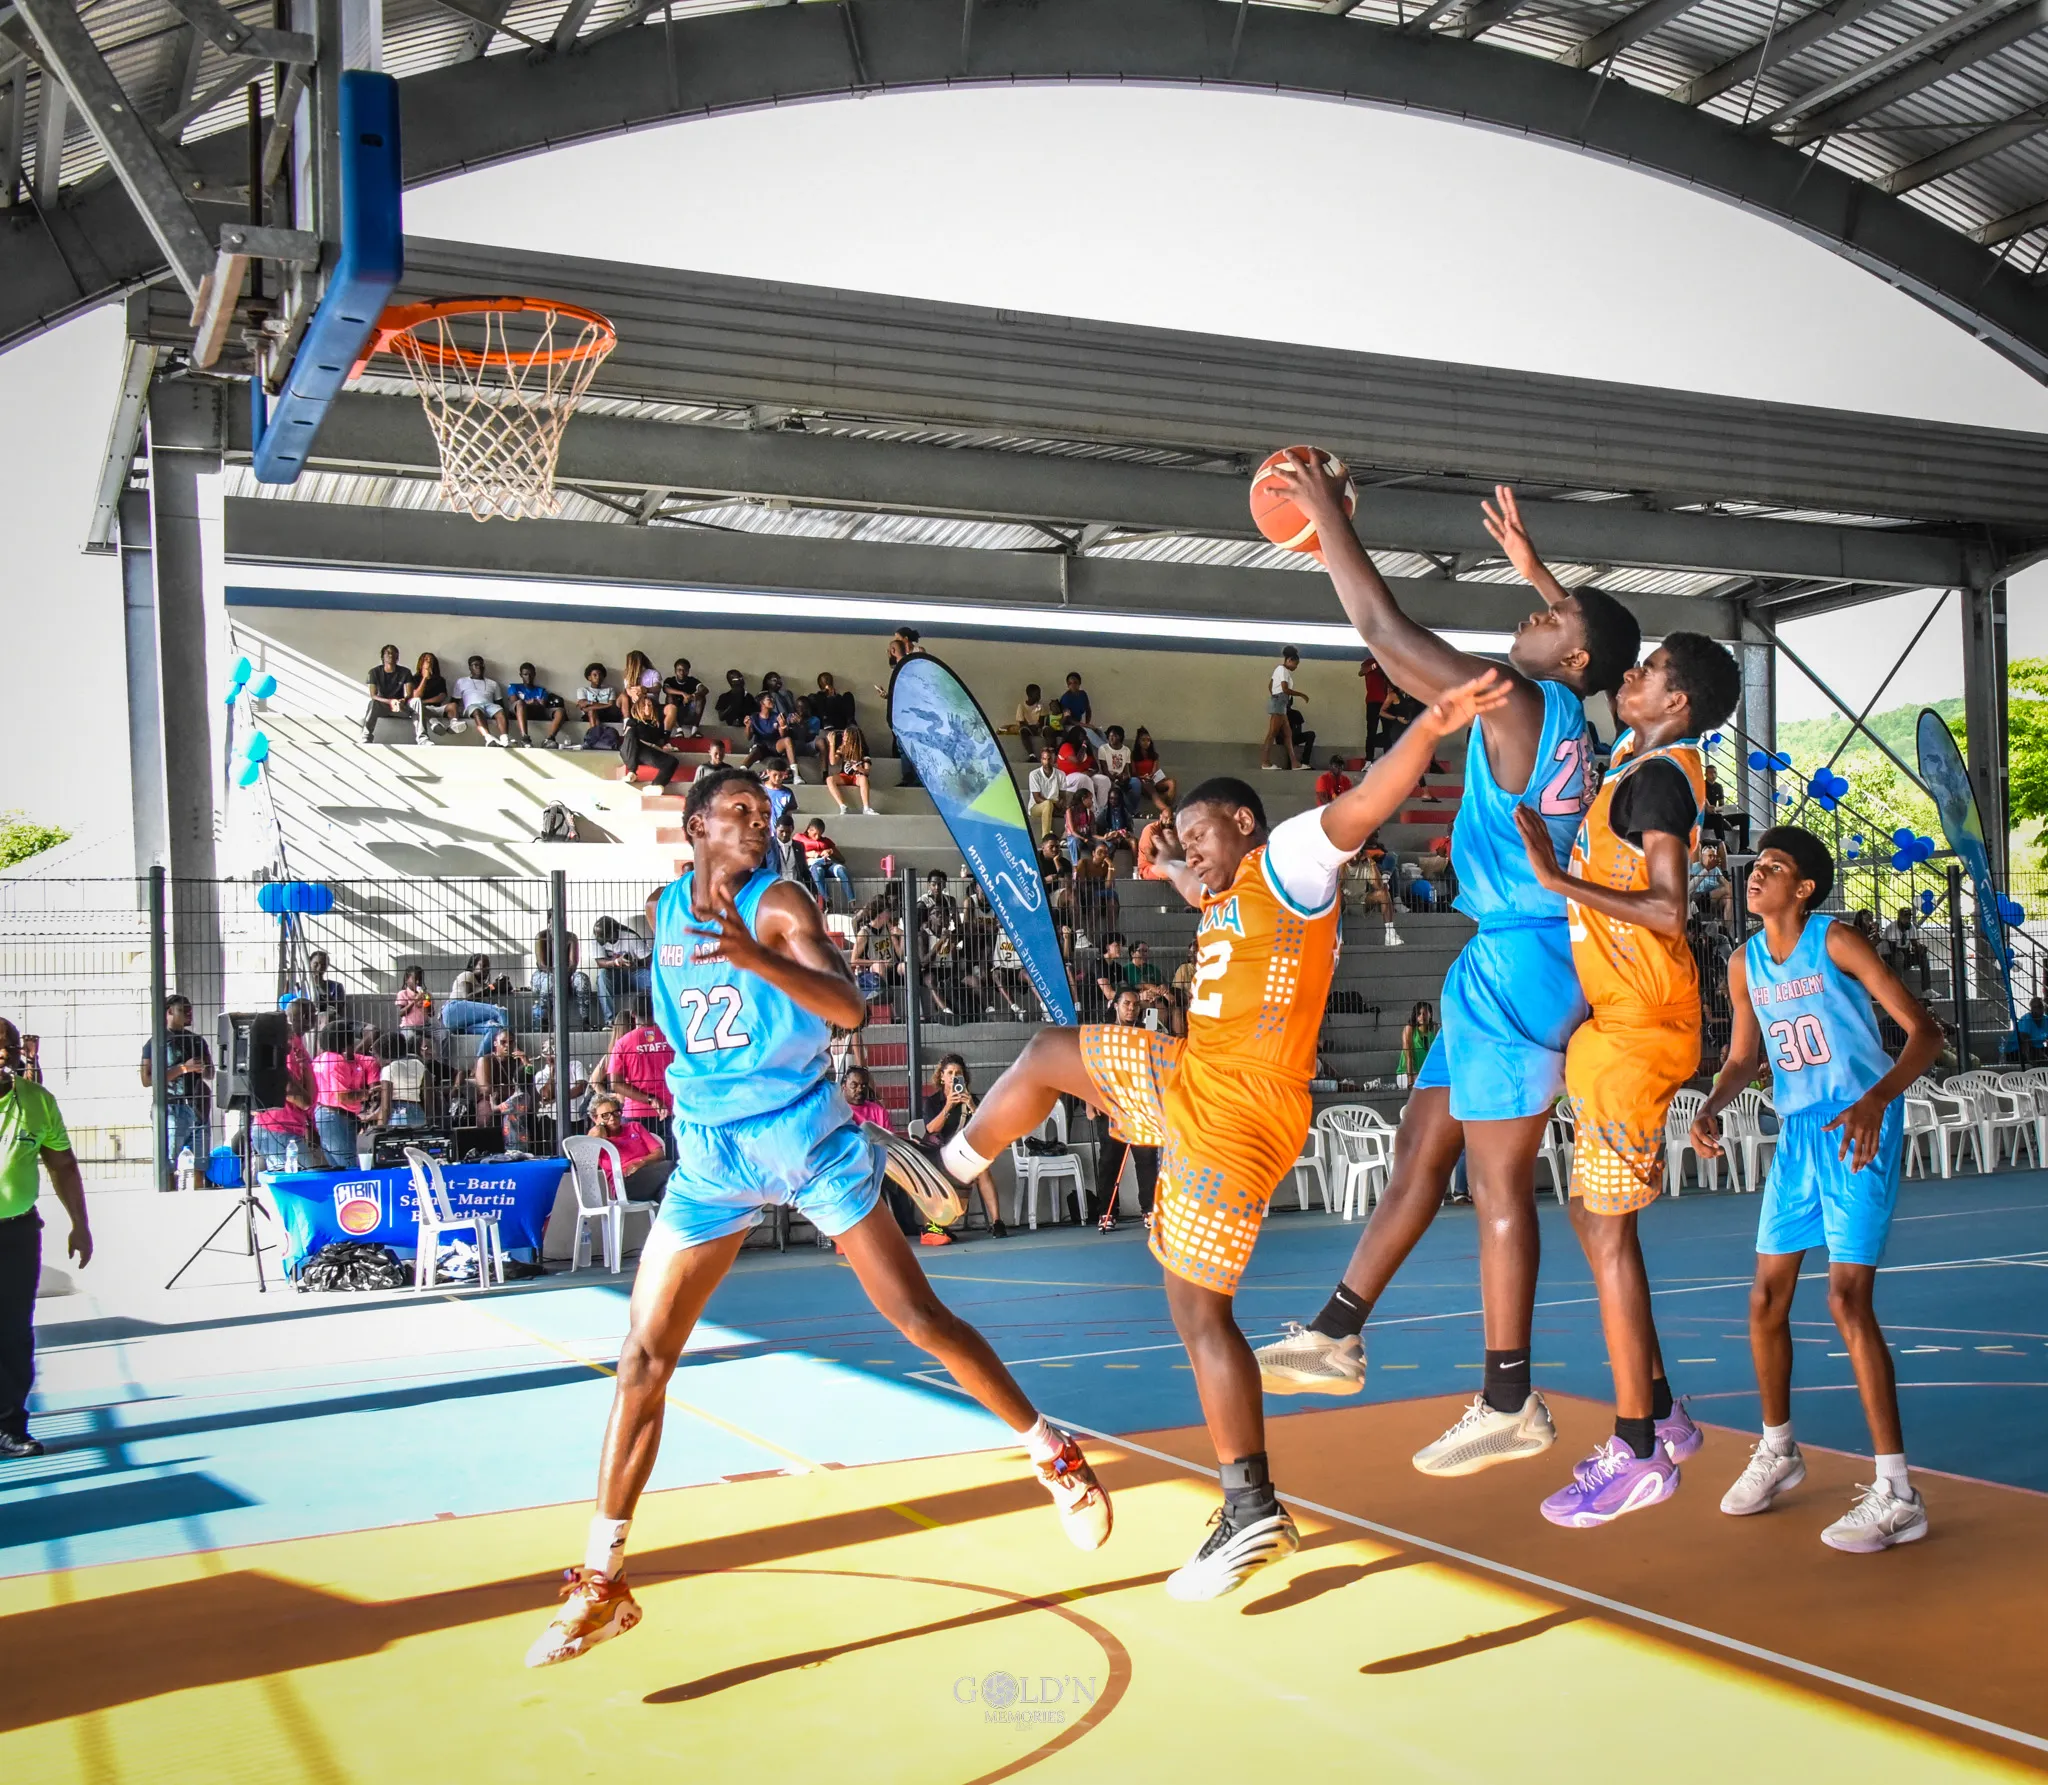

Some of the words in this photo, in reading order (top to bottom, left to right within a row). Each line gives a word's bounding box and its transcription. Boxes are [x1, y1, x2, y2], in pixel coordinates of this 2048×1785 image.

[1775, 973, 1824, 1003] ACADEMY
[680, 984, 751, 1054] 22
[636, 1042, 668, 1054] STAFF
[1769, 1013, 1832, 1073] 30
